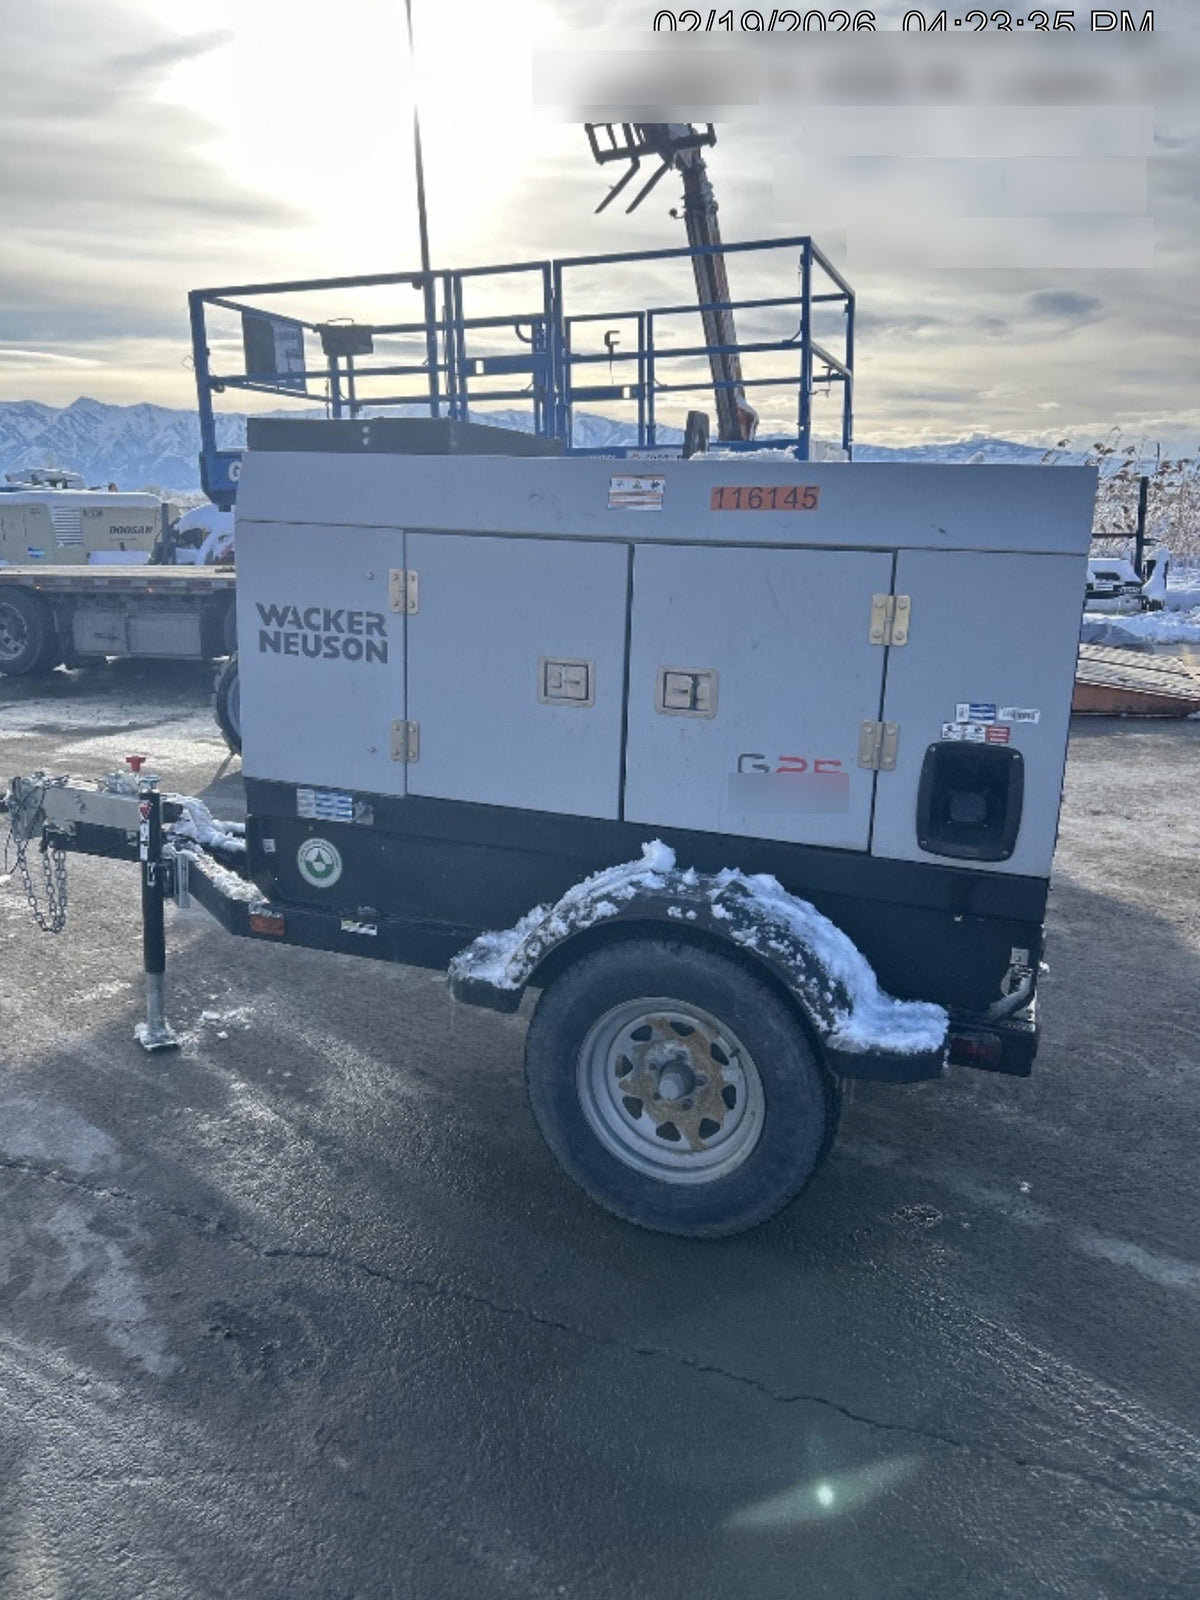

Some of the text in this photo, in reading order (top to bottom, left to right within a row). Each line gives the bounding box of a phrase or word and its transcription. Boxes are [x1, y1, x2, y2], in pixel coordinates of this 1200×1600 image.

[713, 486, 818, 510] 116145
[109, 525, 153, 534] DOOSAN
[255, 602, 388, 637] WACKER
[258, 629, 388, 664] NEUSON
